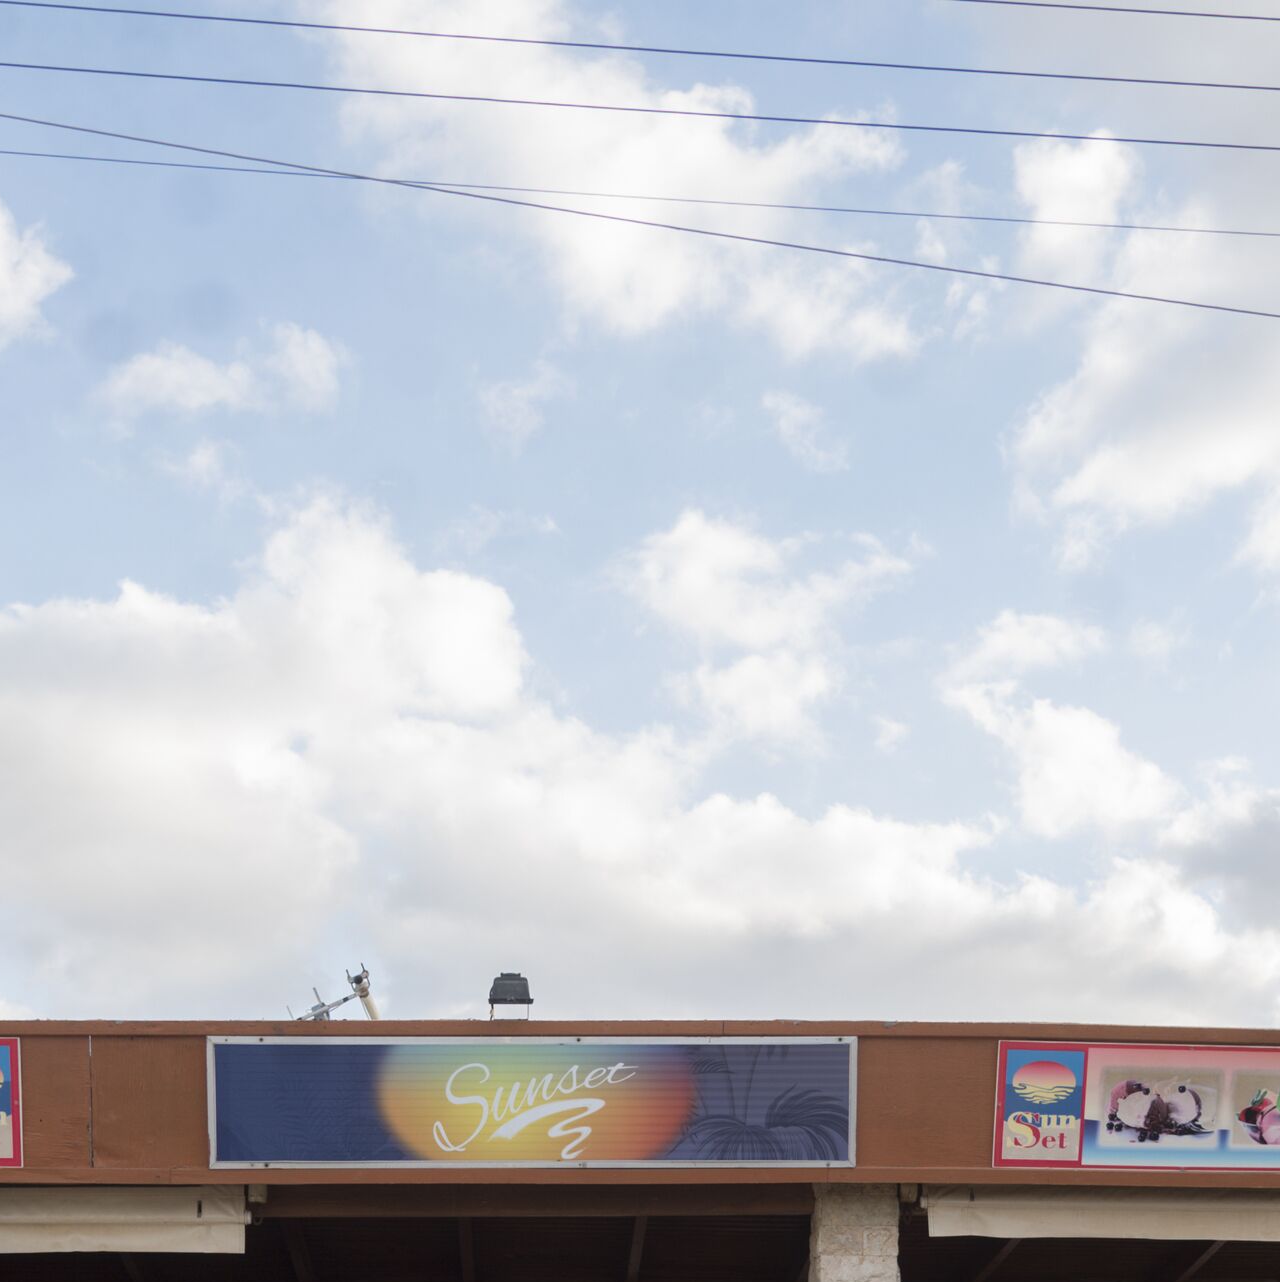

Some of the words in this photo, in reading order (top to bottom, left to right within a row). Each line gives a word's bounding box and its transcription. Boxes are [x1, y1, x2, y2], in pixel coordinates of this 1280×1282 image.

[433, 1061, 638, 1152] Sunset
[1007, 1111, 1076, 1149] Sun
[1013, 1112, 1067, 1149] Set
